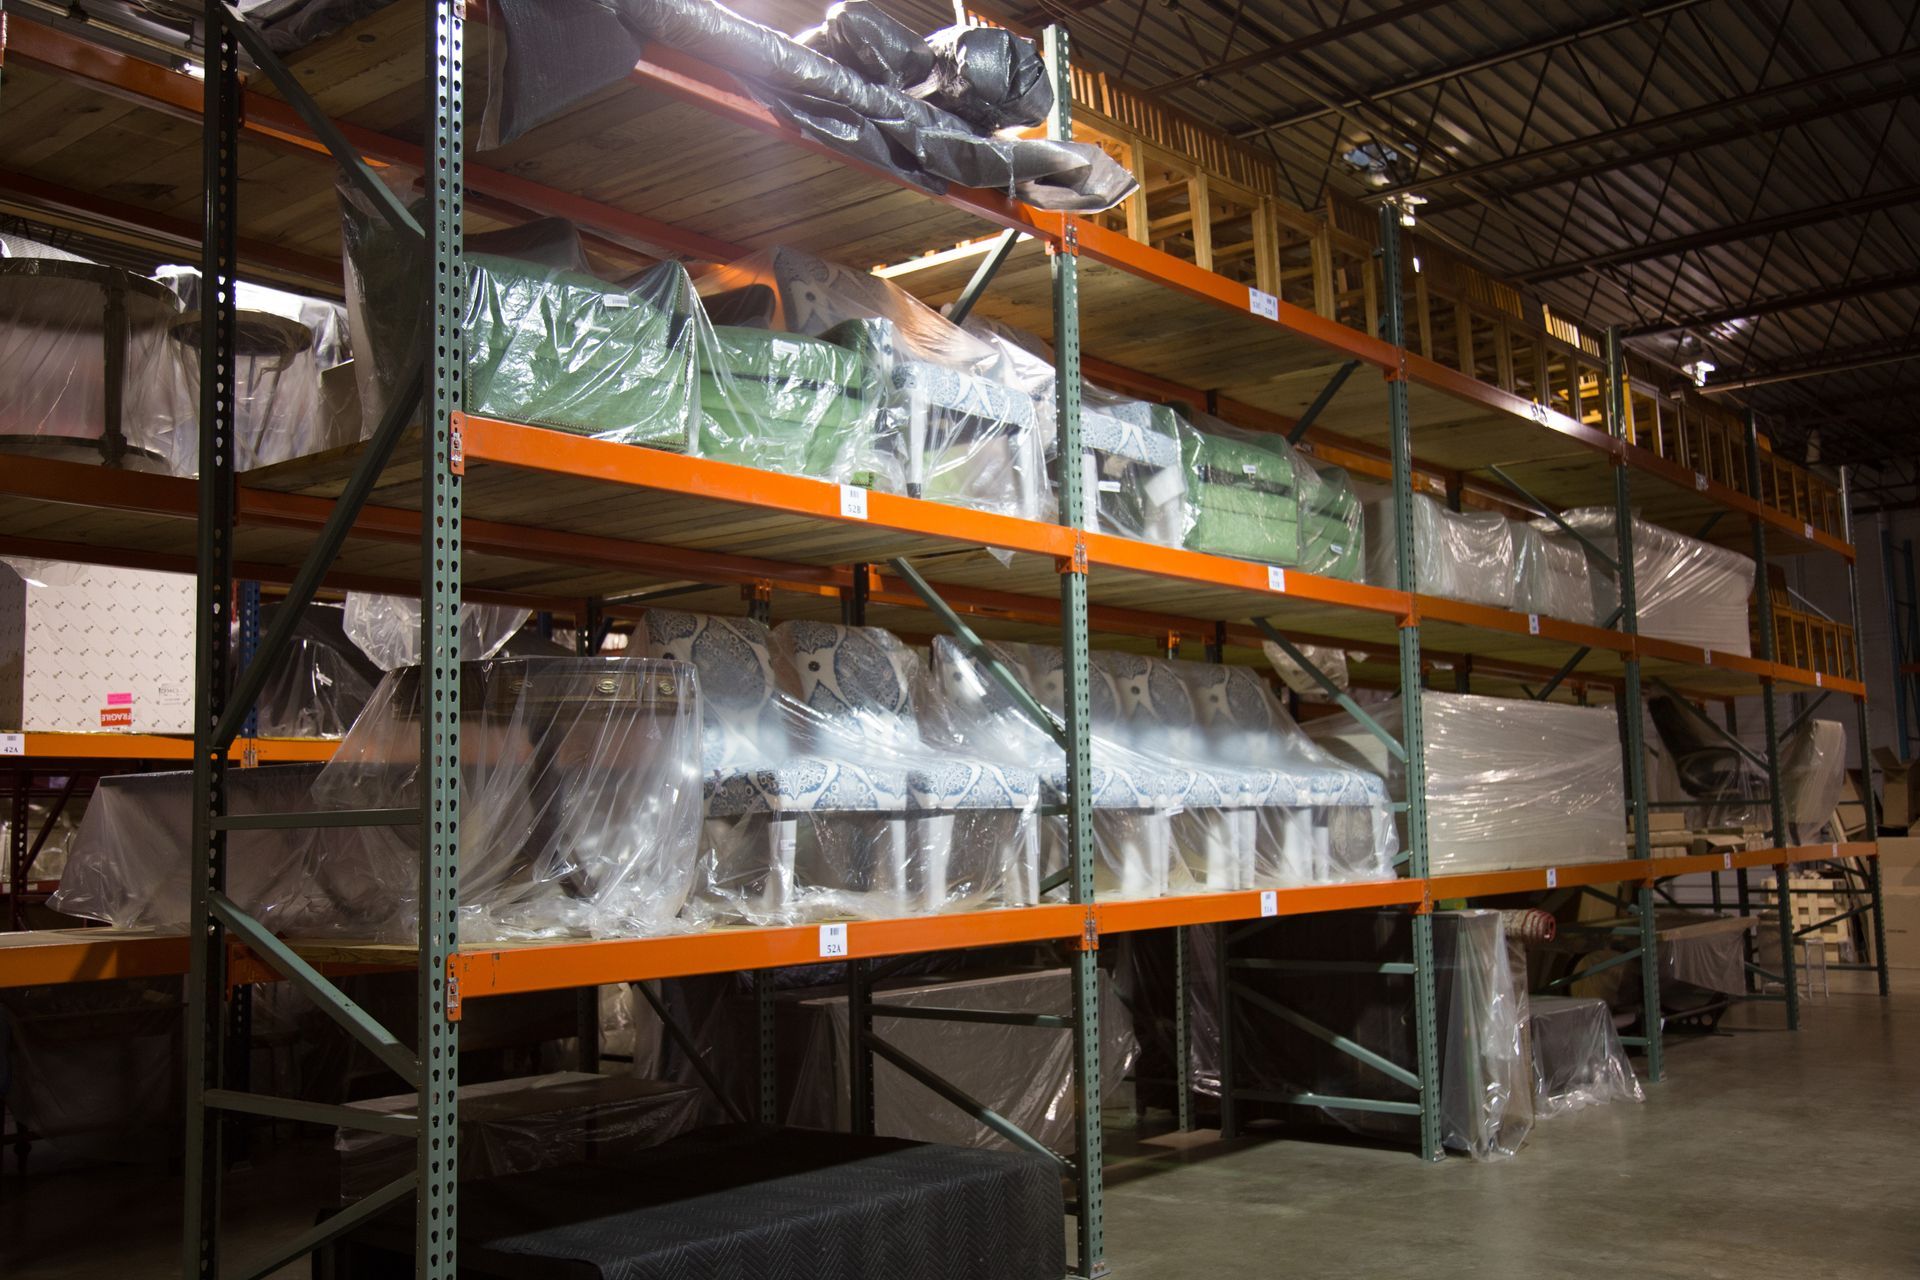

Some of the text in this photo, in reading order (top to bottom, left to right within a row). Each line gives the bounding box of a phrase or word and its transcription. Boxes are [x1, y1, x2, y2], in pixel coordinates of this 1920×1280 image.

[848, 503, 861, 514] 52B
[102, 712, 132, 722] FRAGILE
[827, 944, 841, 954] 52A
